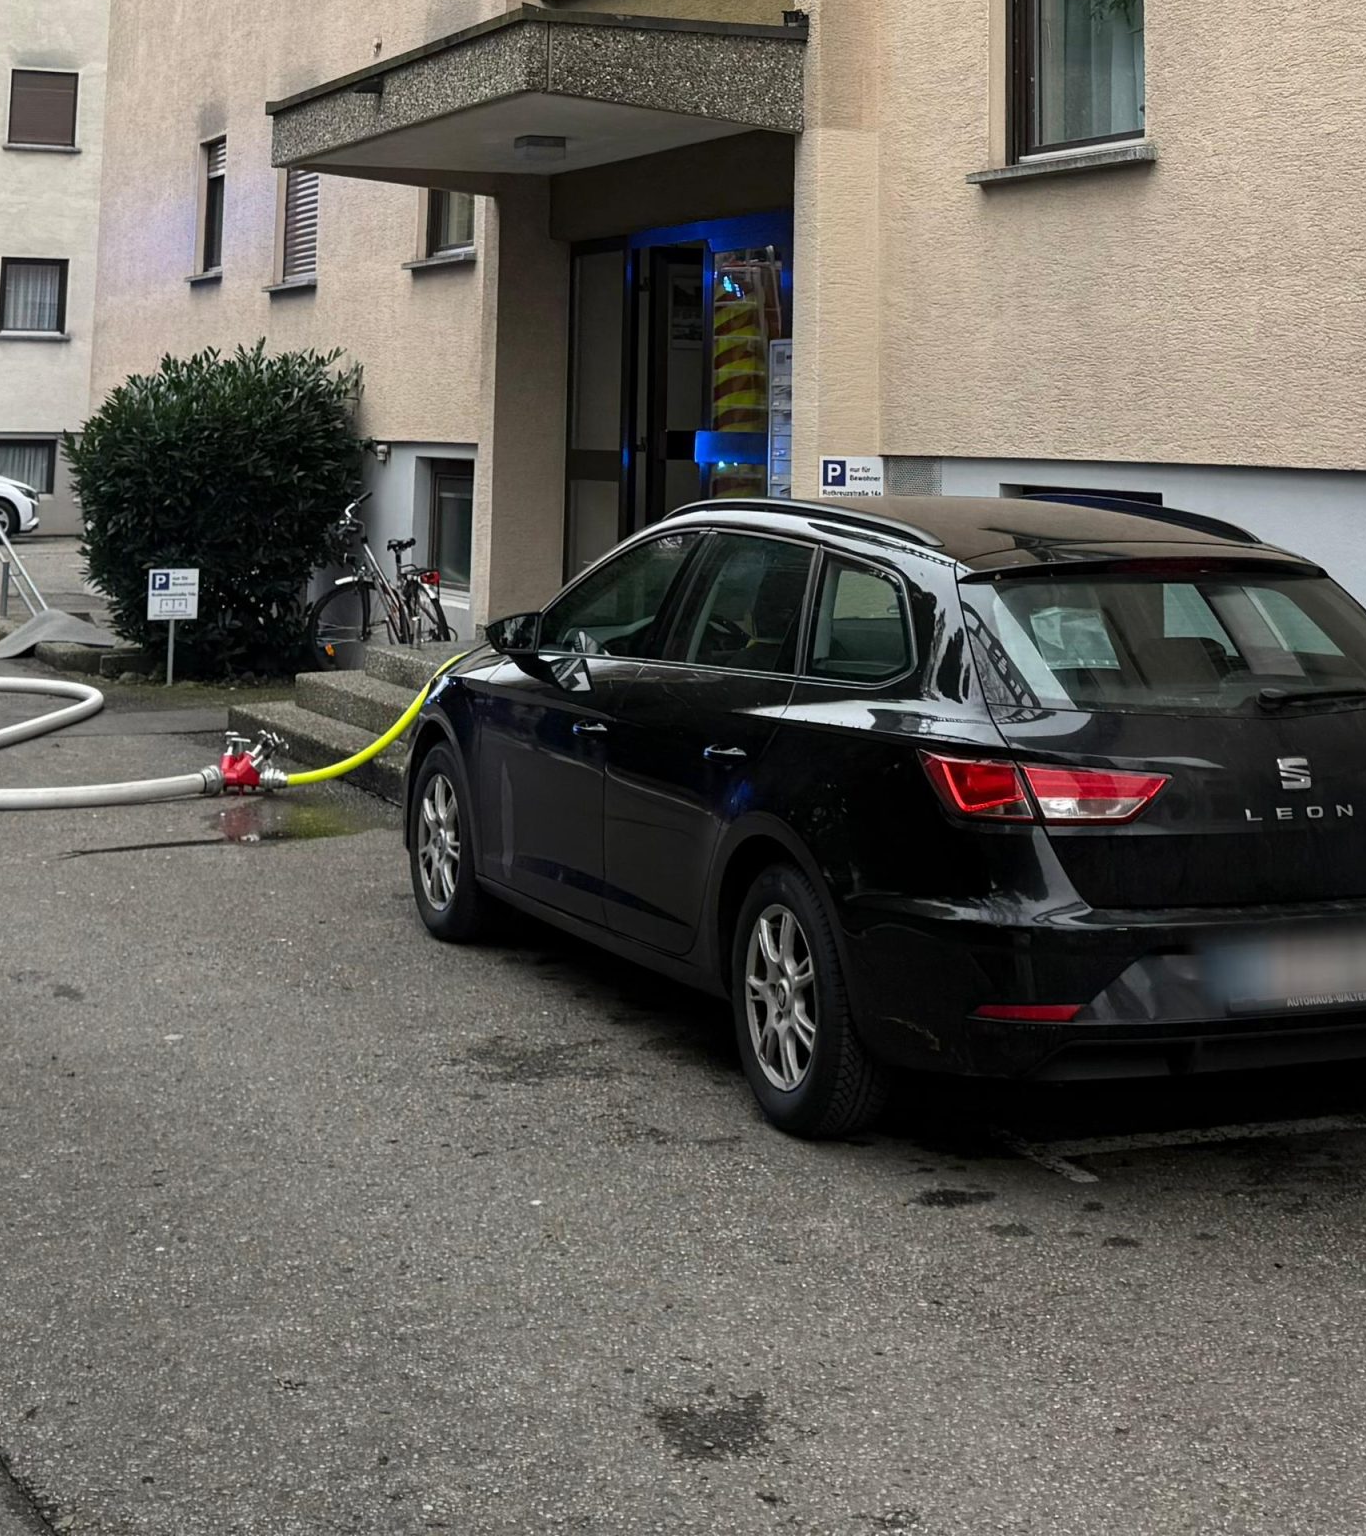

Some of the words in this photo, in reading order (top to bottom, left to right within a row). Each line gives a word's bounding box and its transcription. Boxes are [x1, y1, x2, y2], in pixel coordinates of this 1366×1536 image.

[827, 464, 841, 483] P
[849, 474, 881, 482] Bewohner
[1245, 804, 1354, 821] LEON
